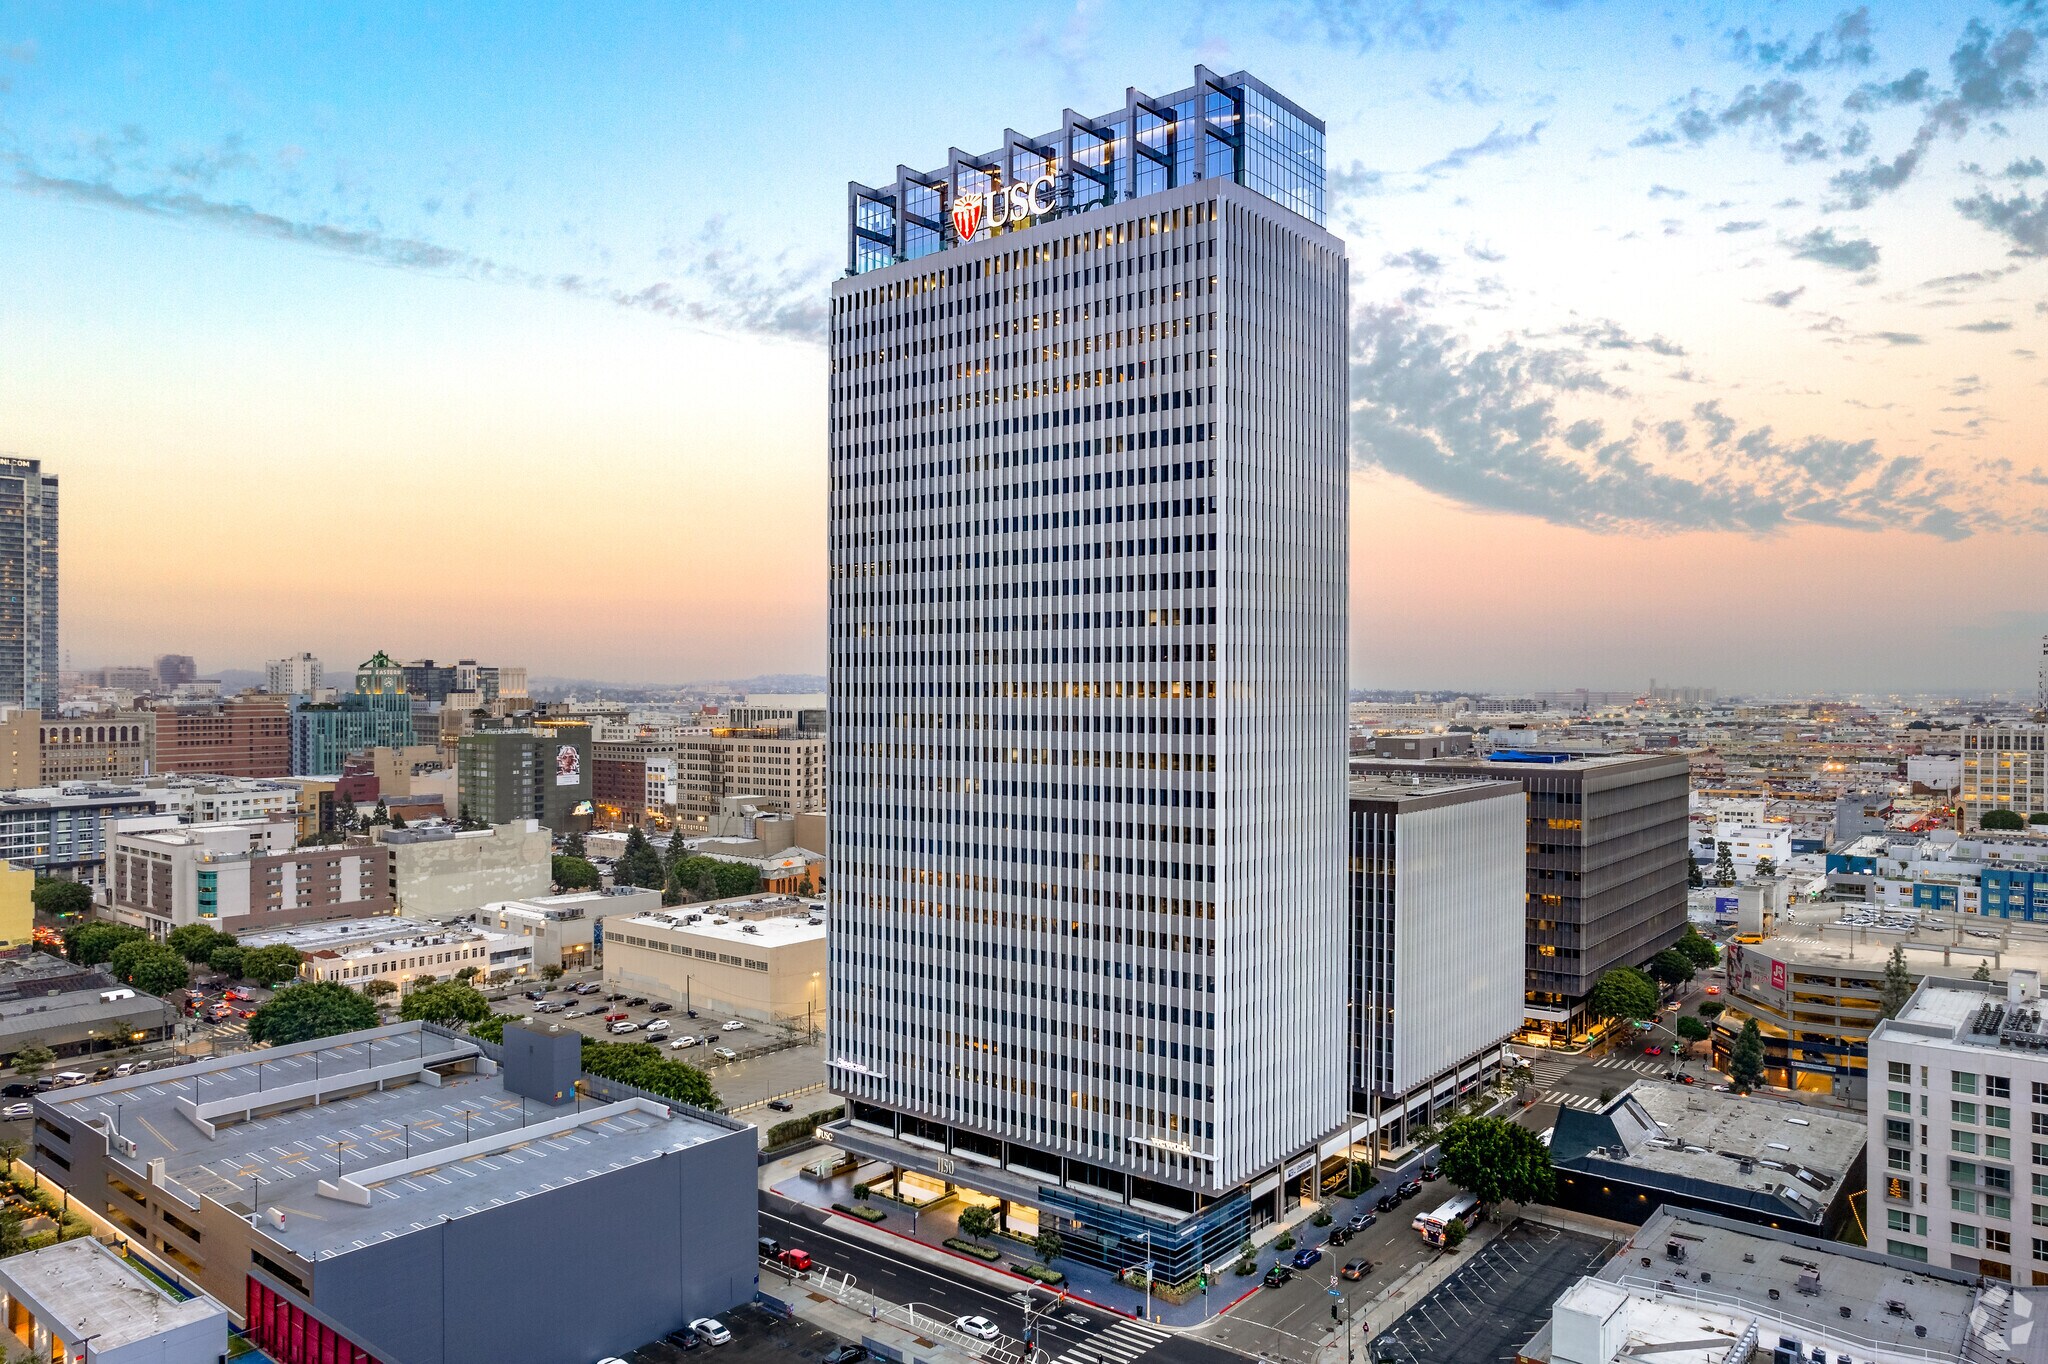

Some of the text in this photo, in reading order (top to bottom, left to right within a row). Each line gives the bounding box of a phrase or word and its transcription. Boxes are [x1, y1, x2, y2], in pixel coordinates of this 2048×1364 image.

[983, 175, 1057, 228] USC
[0, 458, 30, 467] NI.COM
[821, 1130, 834, 1142] USC
